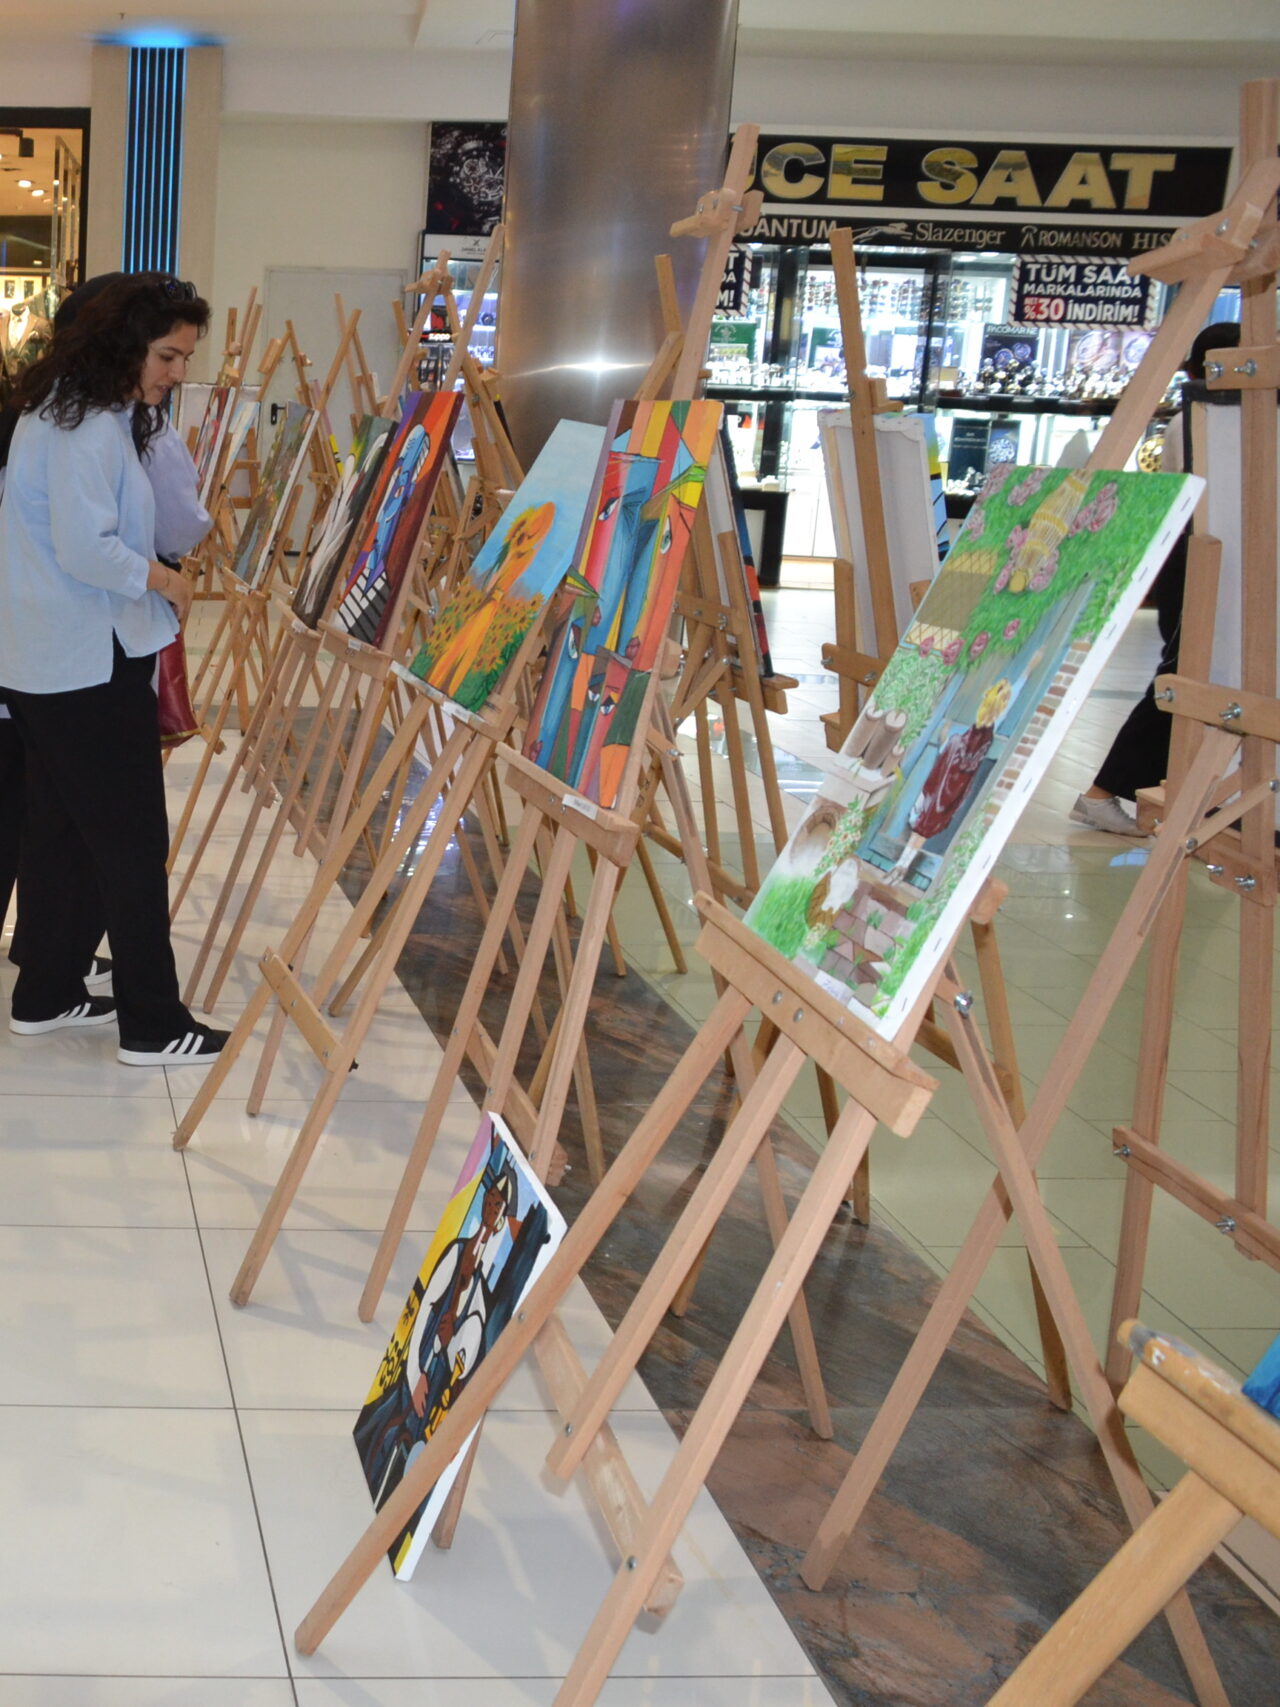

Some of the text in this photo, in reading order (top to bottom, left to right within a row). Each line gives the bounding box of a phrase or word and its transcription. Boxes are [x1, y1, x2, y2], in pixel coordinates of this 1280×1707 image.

[917, 147, 1177, 210] SAAT
[739, 217, 837, 239] ANTUM
[915, 222, 1007, 249] Slazenger
[1038, 230, 1122, 248] ROMANSON
[1132, 232, 1172, 249] HIS
[1026, 263, 1077, 283] TÜM
[1022, 283, 1143, 299] MARKALARINDA
[1066, 299, 1140, 323] İNDİRİM!
